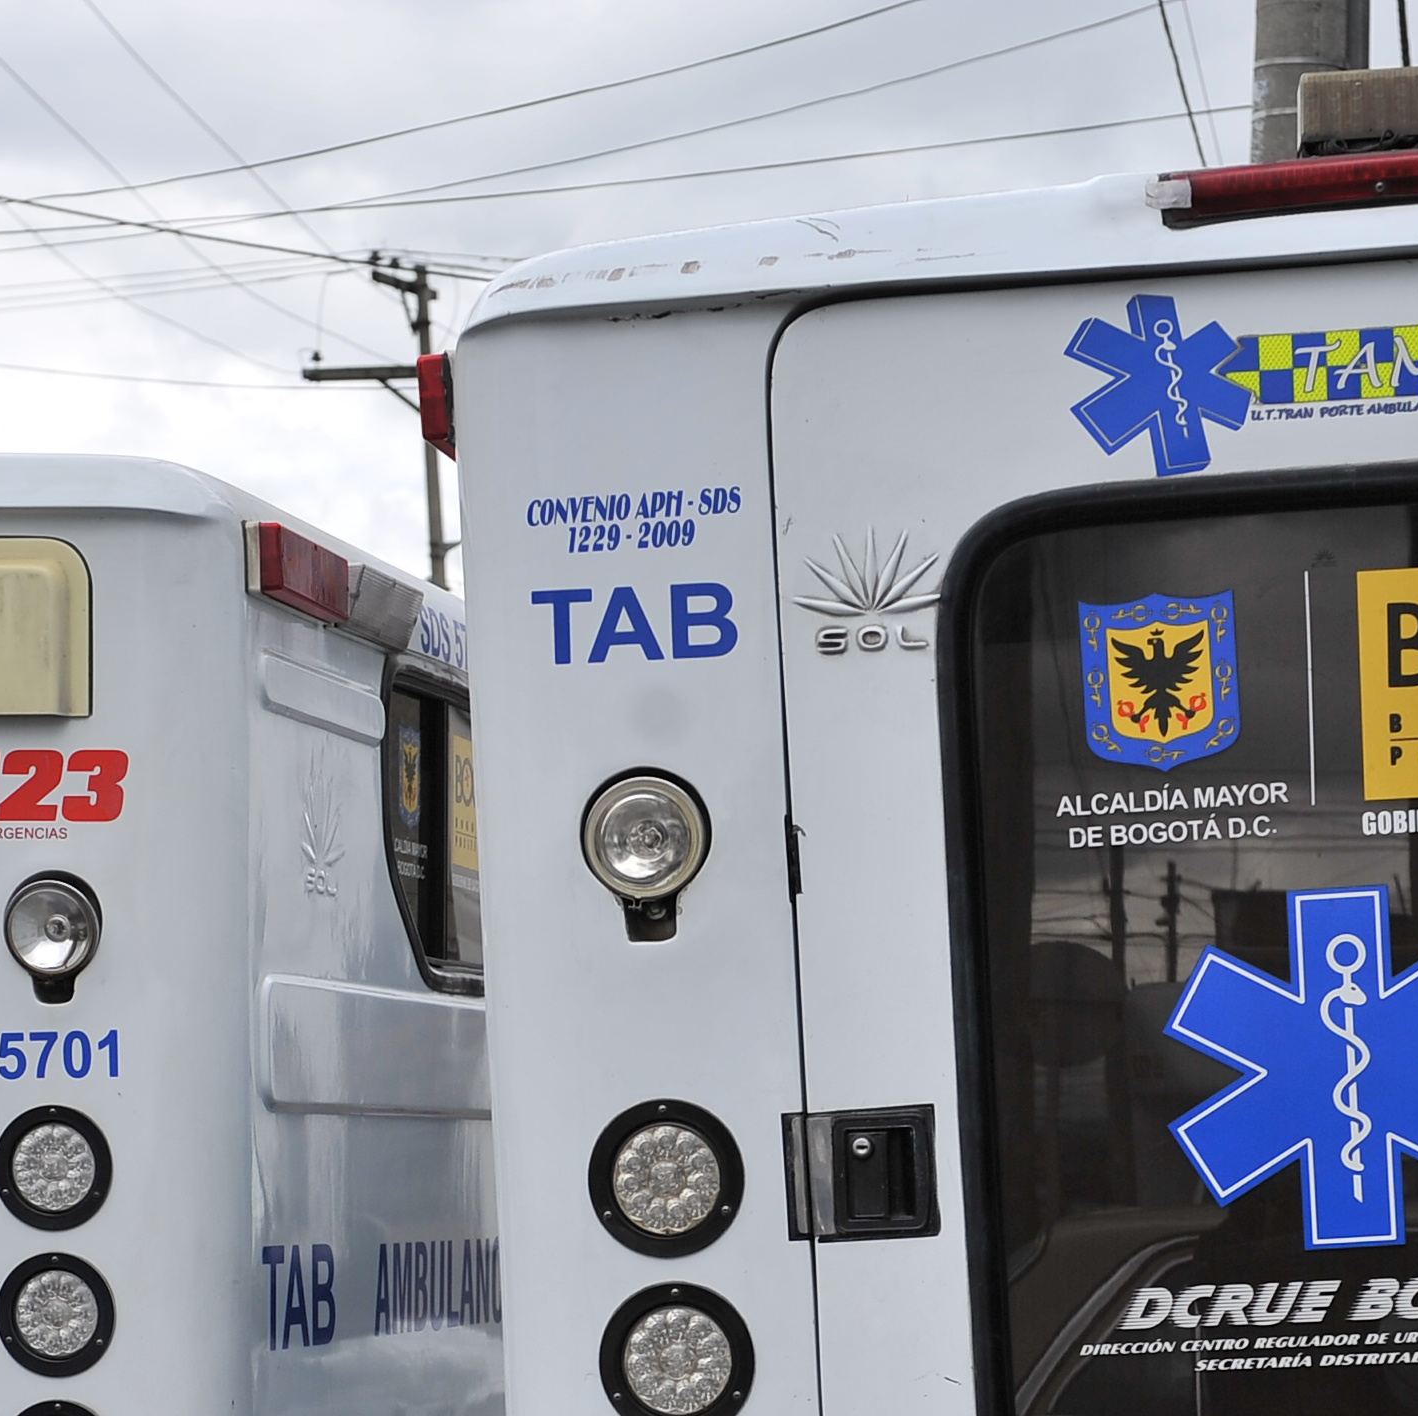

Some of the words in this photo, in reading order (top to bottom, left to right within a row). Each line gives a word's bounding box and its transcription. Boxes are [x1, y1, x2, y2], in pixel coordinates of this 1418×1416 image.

[527, 493, 631, 527] CONVENIO
[698, 486, 741, 516] SDS
[568, 523, 621, 553] 1229
[637, 518, 696, 549] 2009
[531, 582, 738, 665] TAB
[815, 624, 930, 656] SOL
[1056, 783, 1190, 819] ALCALDÍA
[1193, 781, 1290, 811] MAYOR
[1068, 826, 1104, 849] DE
[1110, 813, 1223, 848] BOGOTÁ
[1228, 815, 1278, 840] D.C.
[262, 1243, 336, 1351] TAB
[1114, 1280, 1342, 1330] DCRUE
[1079, 1337, 1177, 1357] DIRECCIÓN
[1180, 1338, 1250, 1353] CENTRO
[1253, 1333, 1361, 1350] REGULADOR
[1363, 1332, 1390, 1346] DE
[1194, 1352, 1313, 1373] SECRETARÍA
